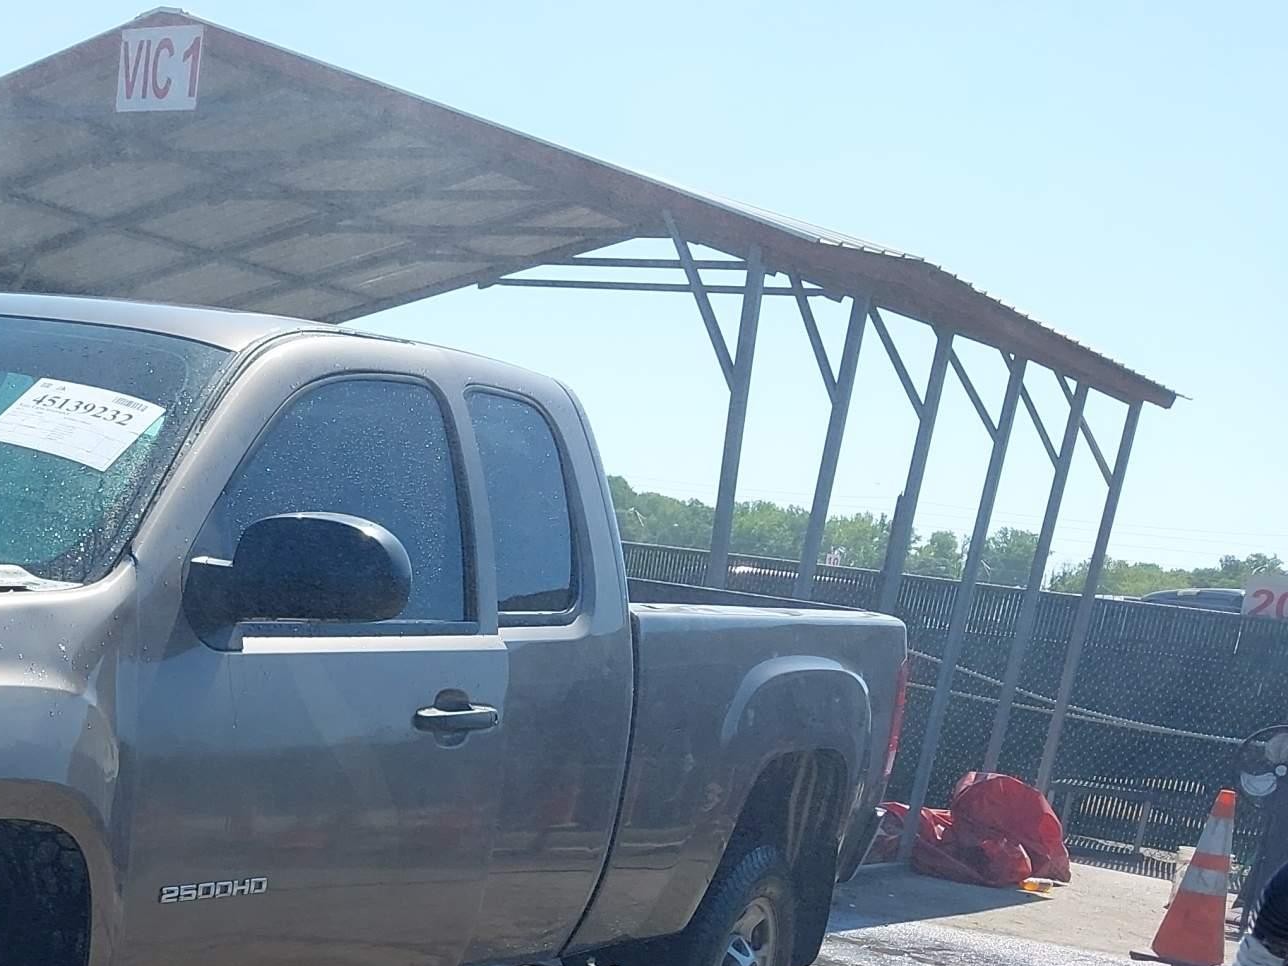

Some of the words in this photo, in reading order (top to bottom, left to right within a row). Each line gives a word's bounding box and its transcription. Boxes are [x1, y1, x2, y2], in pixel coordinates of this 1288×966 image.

[122, 37, 175, 100] VIC
[182, 36, 201, 98] 1
[32, 394, 134, 426] 45139232
[159, 877, 268, 904] 2500HD
